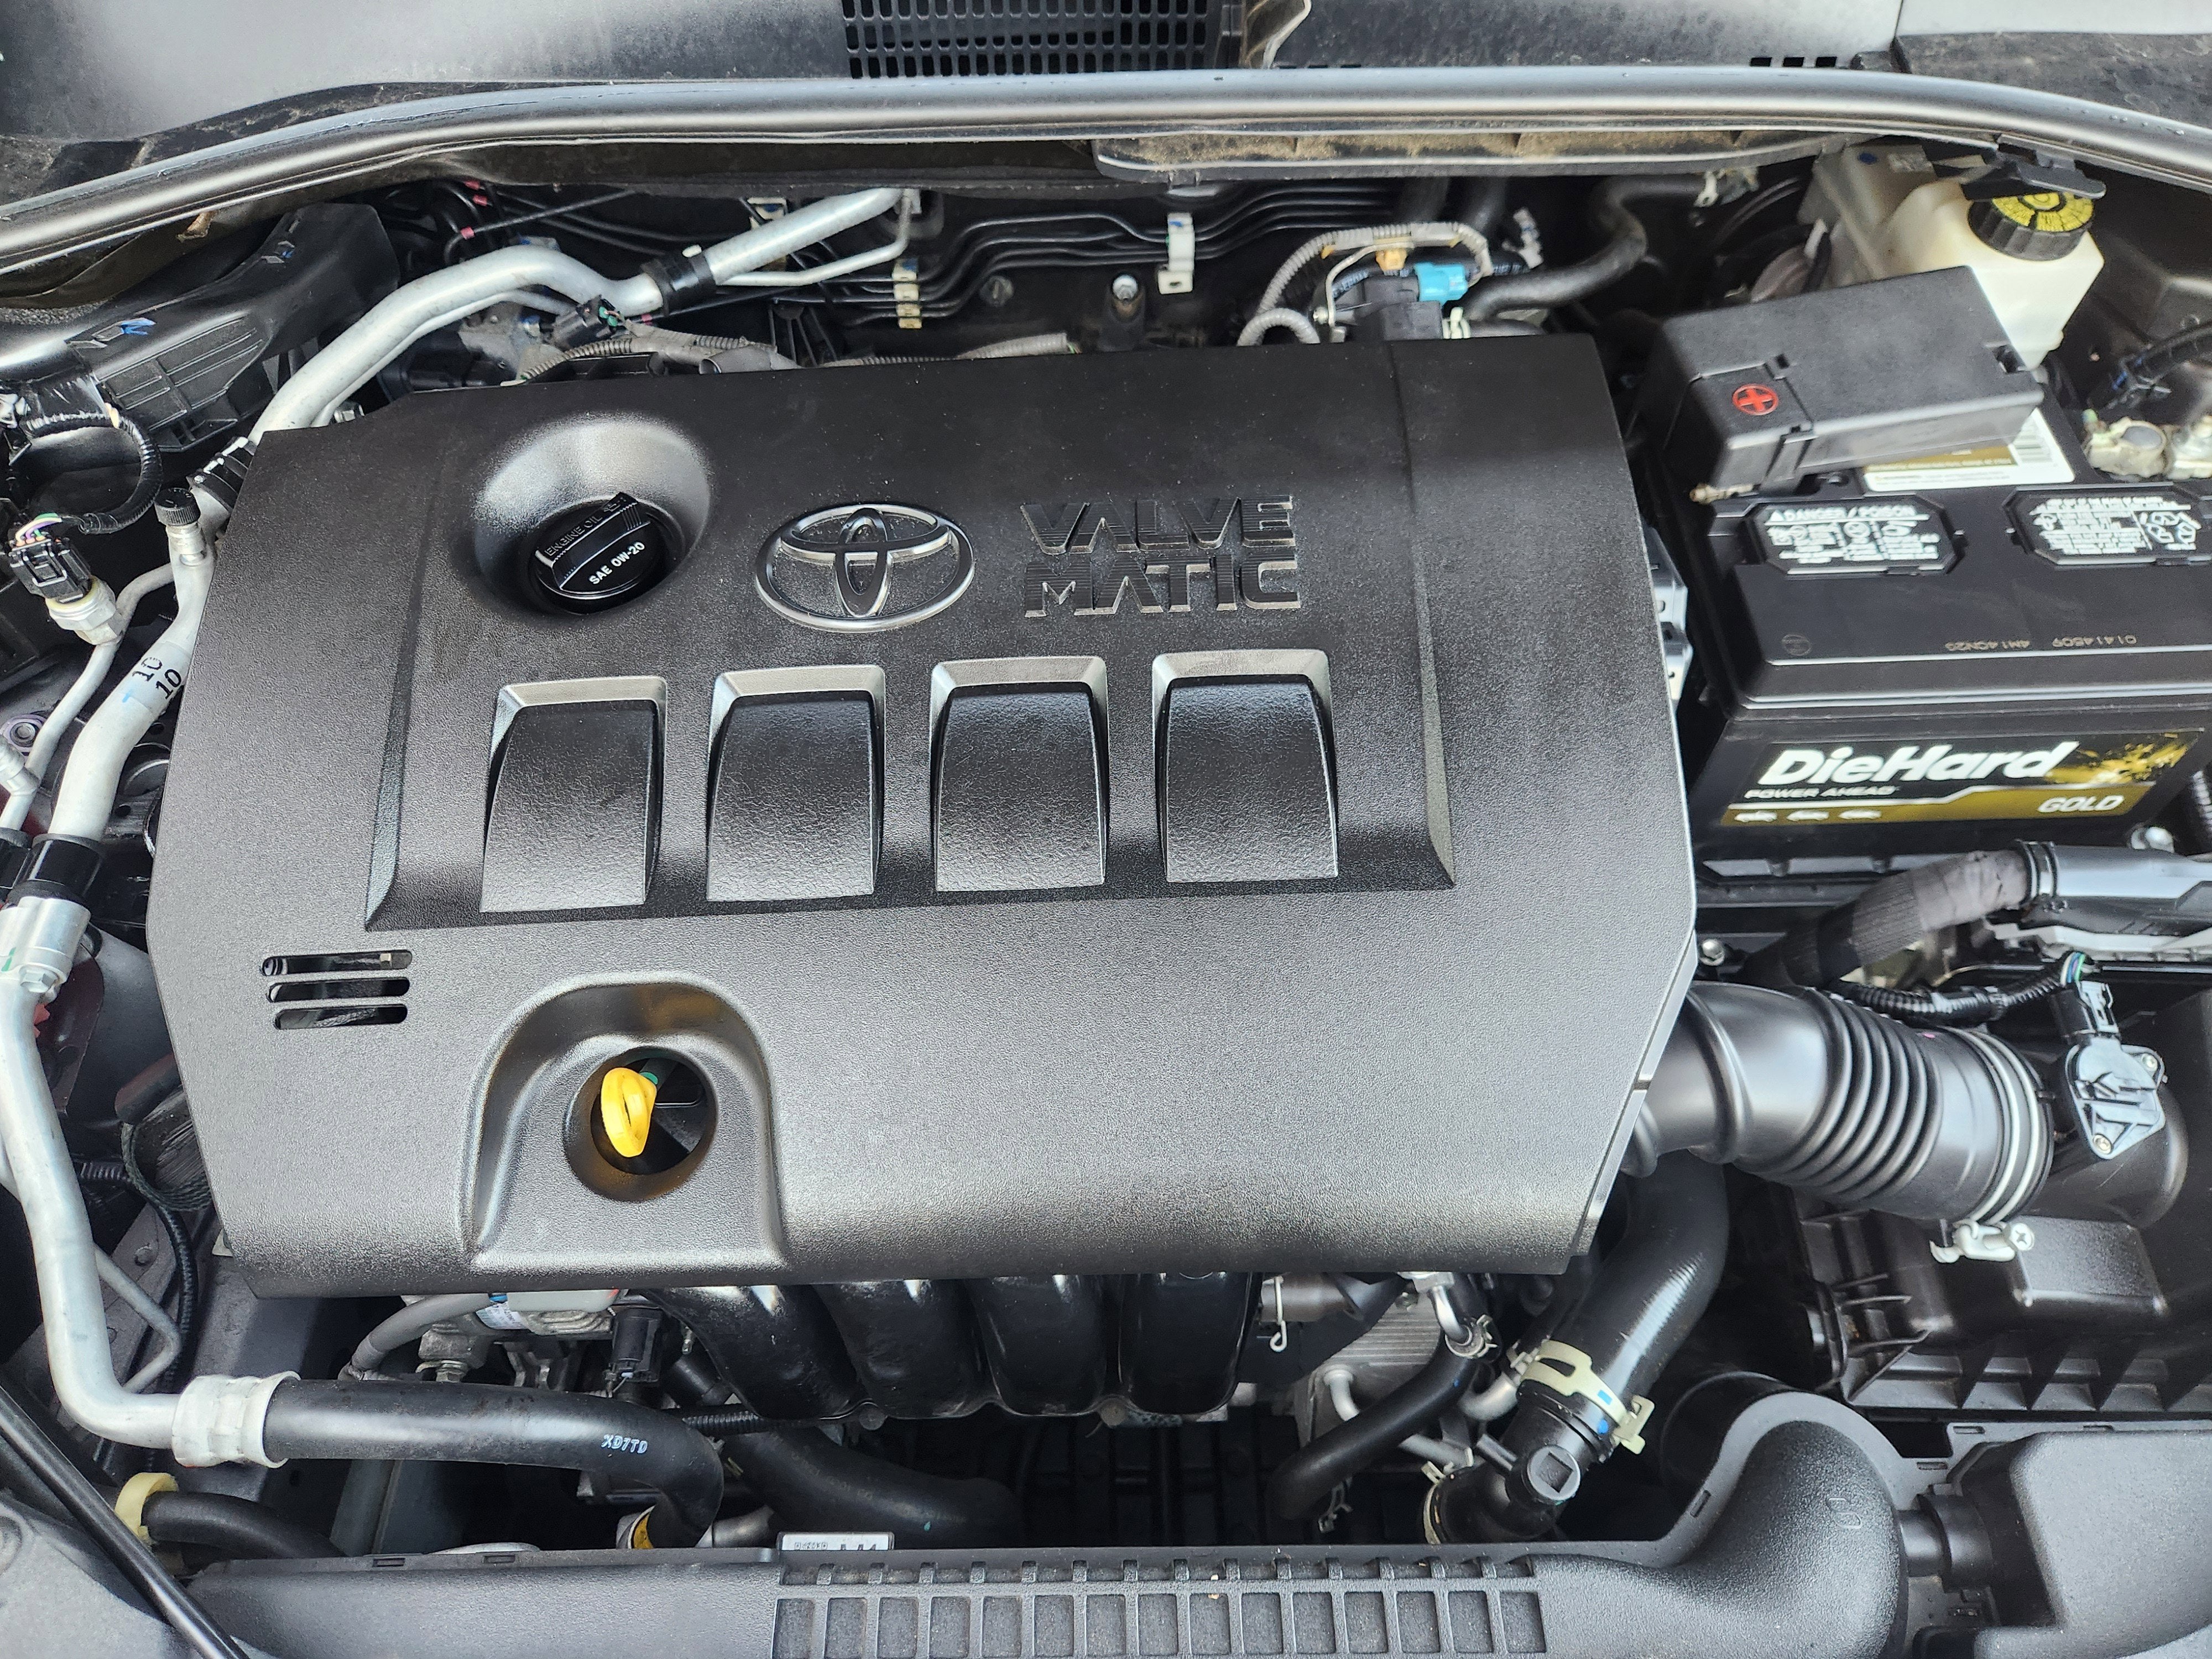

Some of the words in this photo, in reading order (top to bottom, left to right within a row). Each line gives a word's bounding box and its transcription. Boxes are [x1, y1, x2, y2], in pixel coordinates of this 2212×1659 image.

[1020, 495, 1296, 555] VALVE
[1783, 508, 1847, 521] DANGER
[544, 526, 586, 556] ENGINE
[584, 515, 603, 529] OIL
[589, 565, 613, 585] SAE
[1024, 553, 1301, 618] MATIC
[155, 669, 181, 699] 10
[1757, 741, 2079, 785] DieHard
[1744, 787, 1820, 799] POWER
[2037, 795, 2125, 813] GOLD
[601, 1434, 648, 1454] XD7TD
